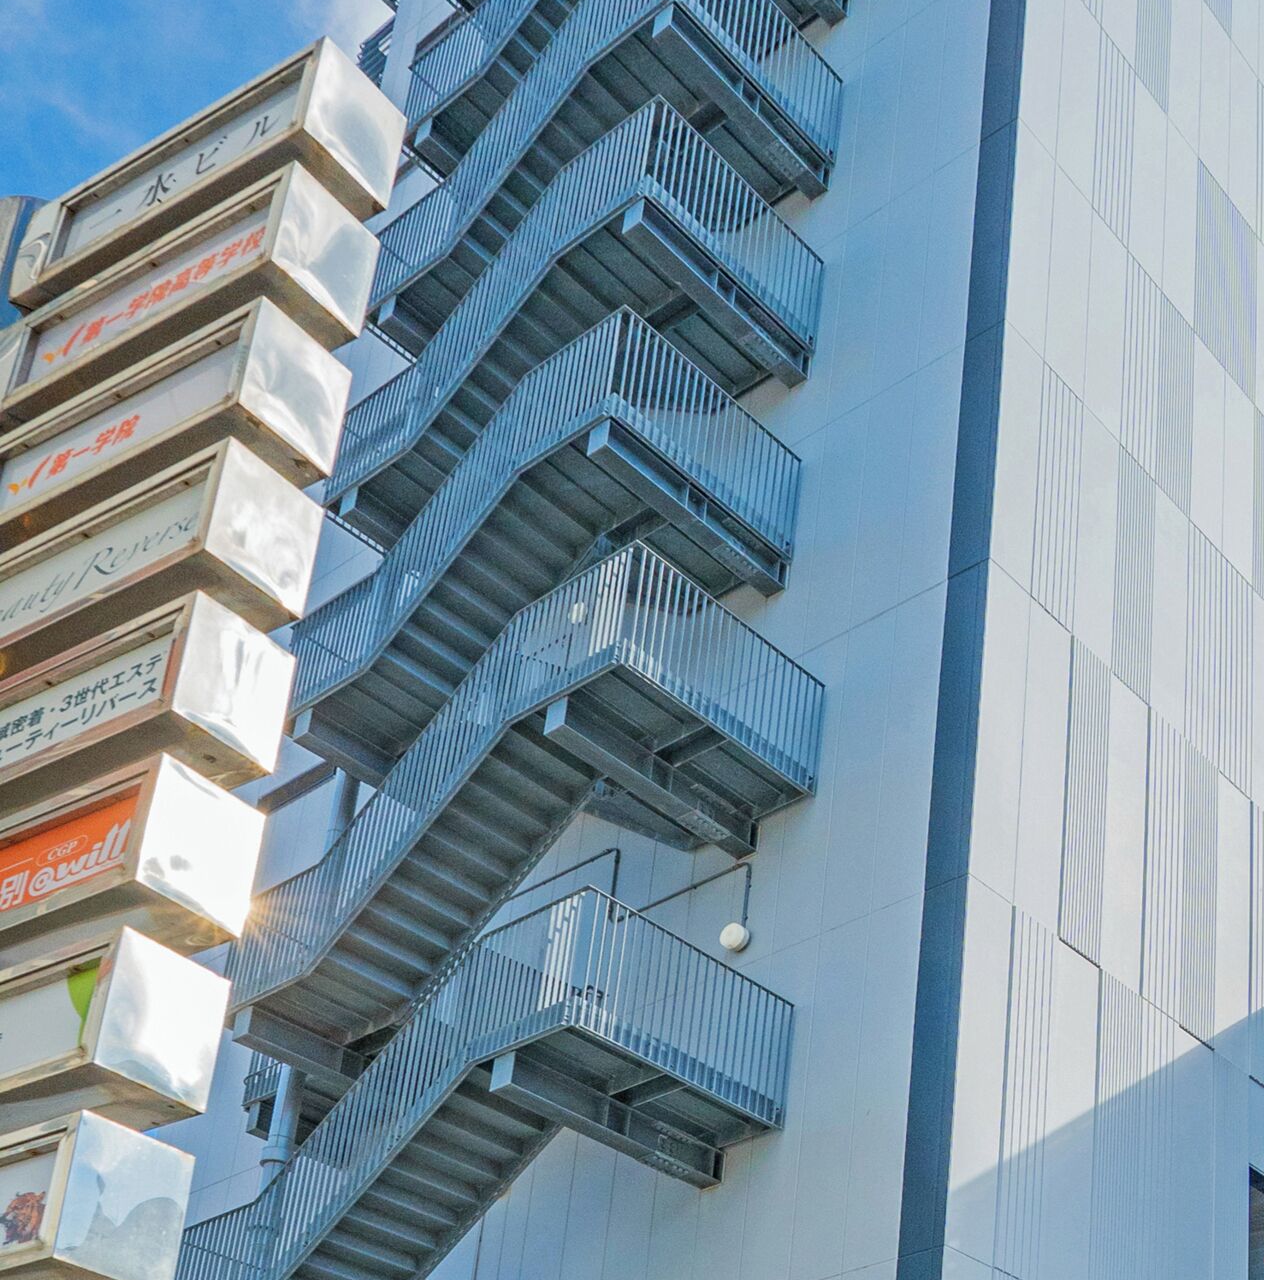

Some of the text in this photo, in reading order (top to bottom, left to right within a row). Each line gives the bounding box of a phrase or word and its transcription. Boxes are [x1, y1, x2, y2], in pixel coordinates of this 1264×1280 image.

[89, 115, 281, 230] 一水ビル
[45, 414, 141, 480] 第一学院
[0, 511, 200, 622] auty Reverse
[0, 677, 158, 761] ーティーリバース
[47, 840, 79, 861] CGP
